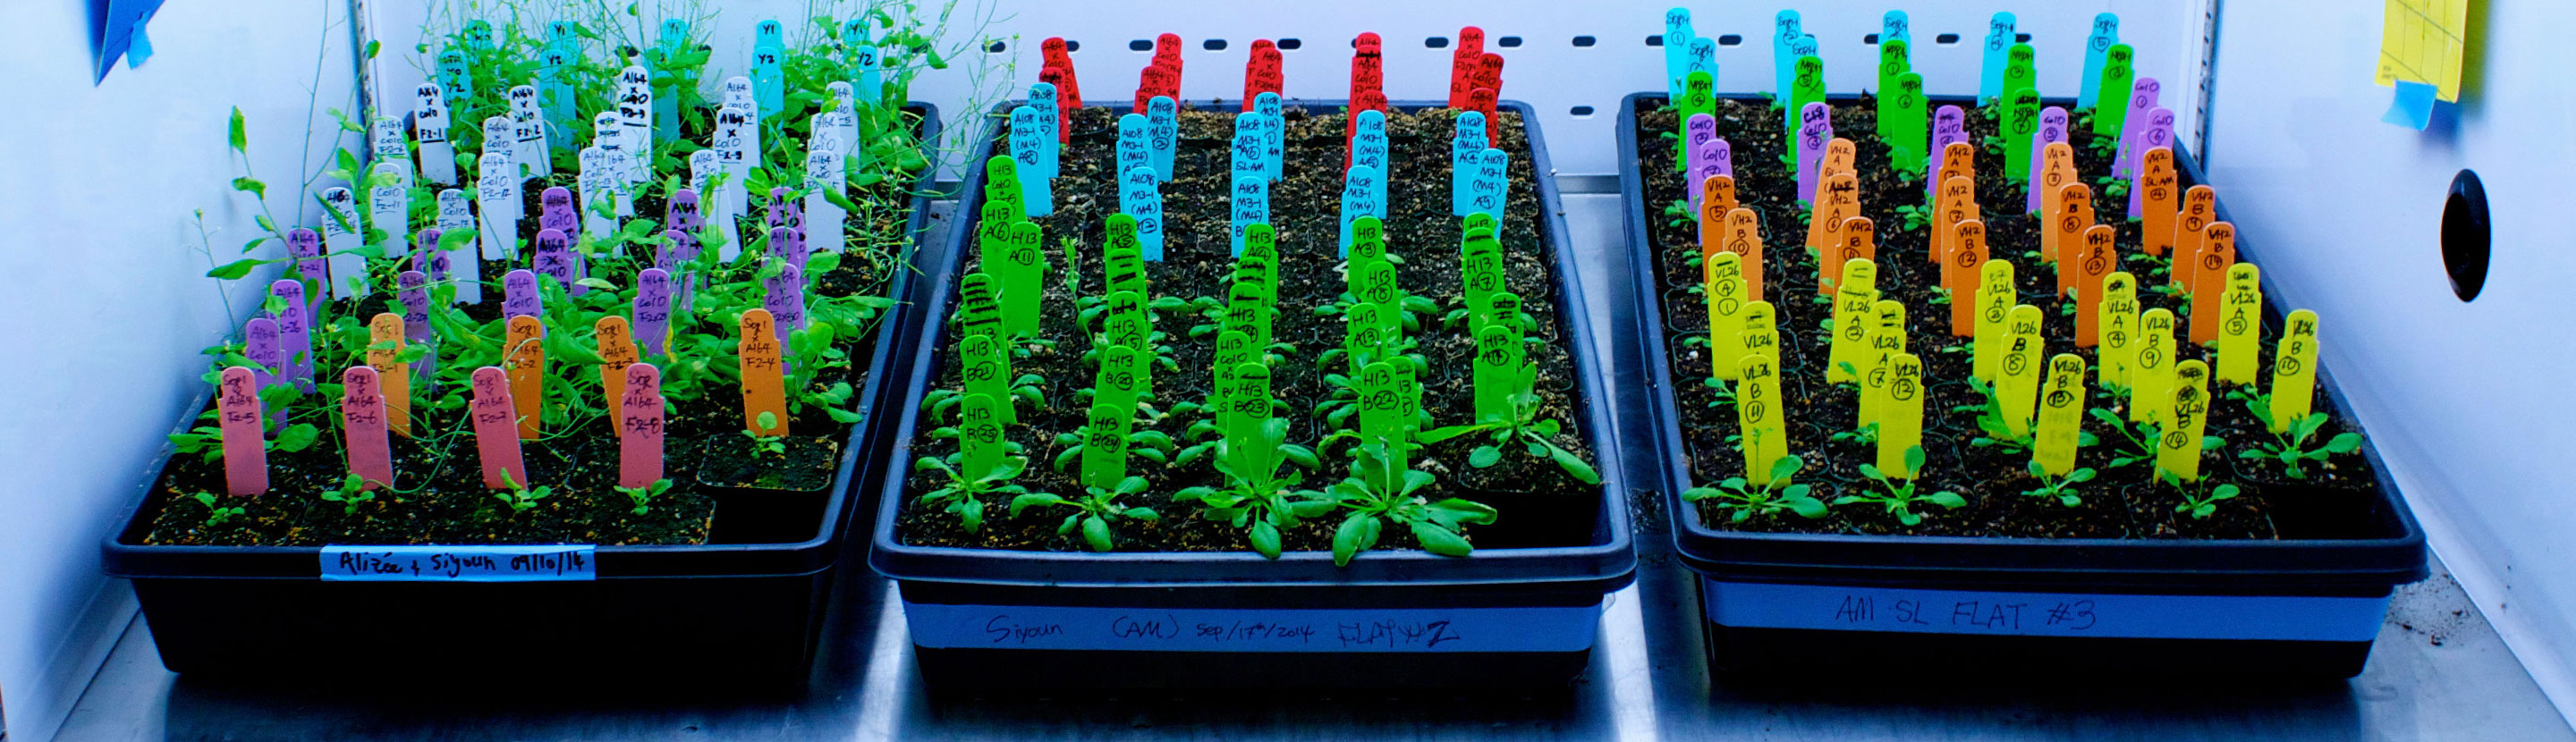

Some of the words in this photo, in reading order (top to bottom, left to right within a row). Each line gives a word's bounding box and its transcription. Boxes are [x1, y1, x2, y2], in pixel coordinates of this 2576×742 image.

[763, 24, 775, 35] Y1
[758, 54, 775, 66] Y2
[858, 52, 874, 66] Y2
[1951, 158, 1960, 167] A
[2052, 161, 2060, 171] A
[2152, 165, 2160, 173] A
[1715, 193, 1722, 202] A
[986, 207, 1009, 222] H13
[1711, 207, 1725, 221] 5
[1833, 207, 1840, 216] A
[1011, 232, 1037, 244] H13
[1737, 229, 1746, 238] B
[1729, 240, 1749, 256] 10
[1965, 239, 1975, 249] B
[2214, 243, 2224, 252] B
[2094, 247, 2104, 257] B
[1959, 252, 1976, 266] 12
[1716, 266, 1740, 278] VL26
[1843, 299, 1870, 313] VL26
[1994, 297, 2004, 307] A
[2107, 302, 2134, 314] VL26
[2233, 308, 2244, 318] A
[1851, 316, 1860, 325] A
[2113, 316, 2123, 328] A
[2146, 317, 2171, 330] VL26
[2227, 319, 2245, 333] 5
[2012, 322, 2037, 334] VL26
[1743, 334, 1772, 349] VL26
[1871, 335, 1899, 350] VL26
[2012, 338, 2027, 351] B
[2108, 333, 2123, 347] 4
[2149, 334, 2159, 347] B
[2291, 341, 2302, 355] B
[747, 358, 775, 370] F2-4
[1879, 353, 1888, 366] A
[2141, 349, 2160, 367] 9
[2055, 360, 2081, 375] VL26
[2279, 357, 2299, 375] 10
[2057, 375, 2068, 388] B
[1750, 384, 1762, 399] B
[1894, 380, 1913, 400] 12
[2178, 416, 2190, 429] B
[2166, 432, 2186, 448] 14
[340, 552, 402, 575] Alizée
[511, 550, 585, 577] 09/10/14
[1835, 594, 1874, 622] AM
[1895, 600, 1928, 625] SL
[1953, 600, 2028, 629] FLAT
[2046, 599, 2096, 629] #3
[987, 614, 1063, 643] Siyoun
[1113, 614, 1179, 640] (AM)
